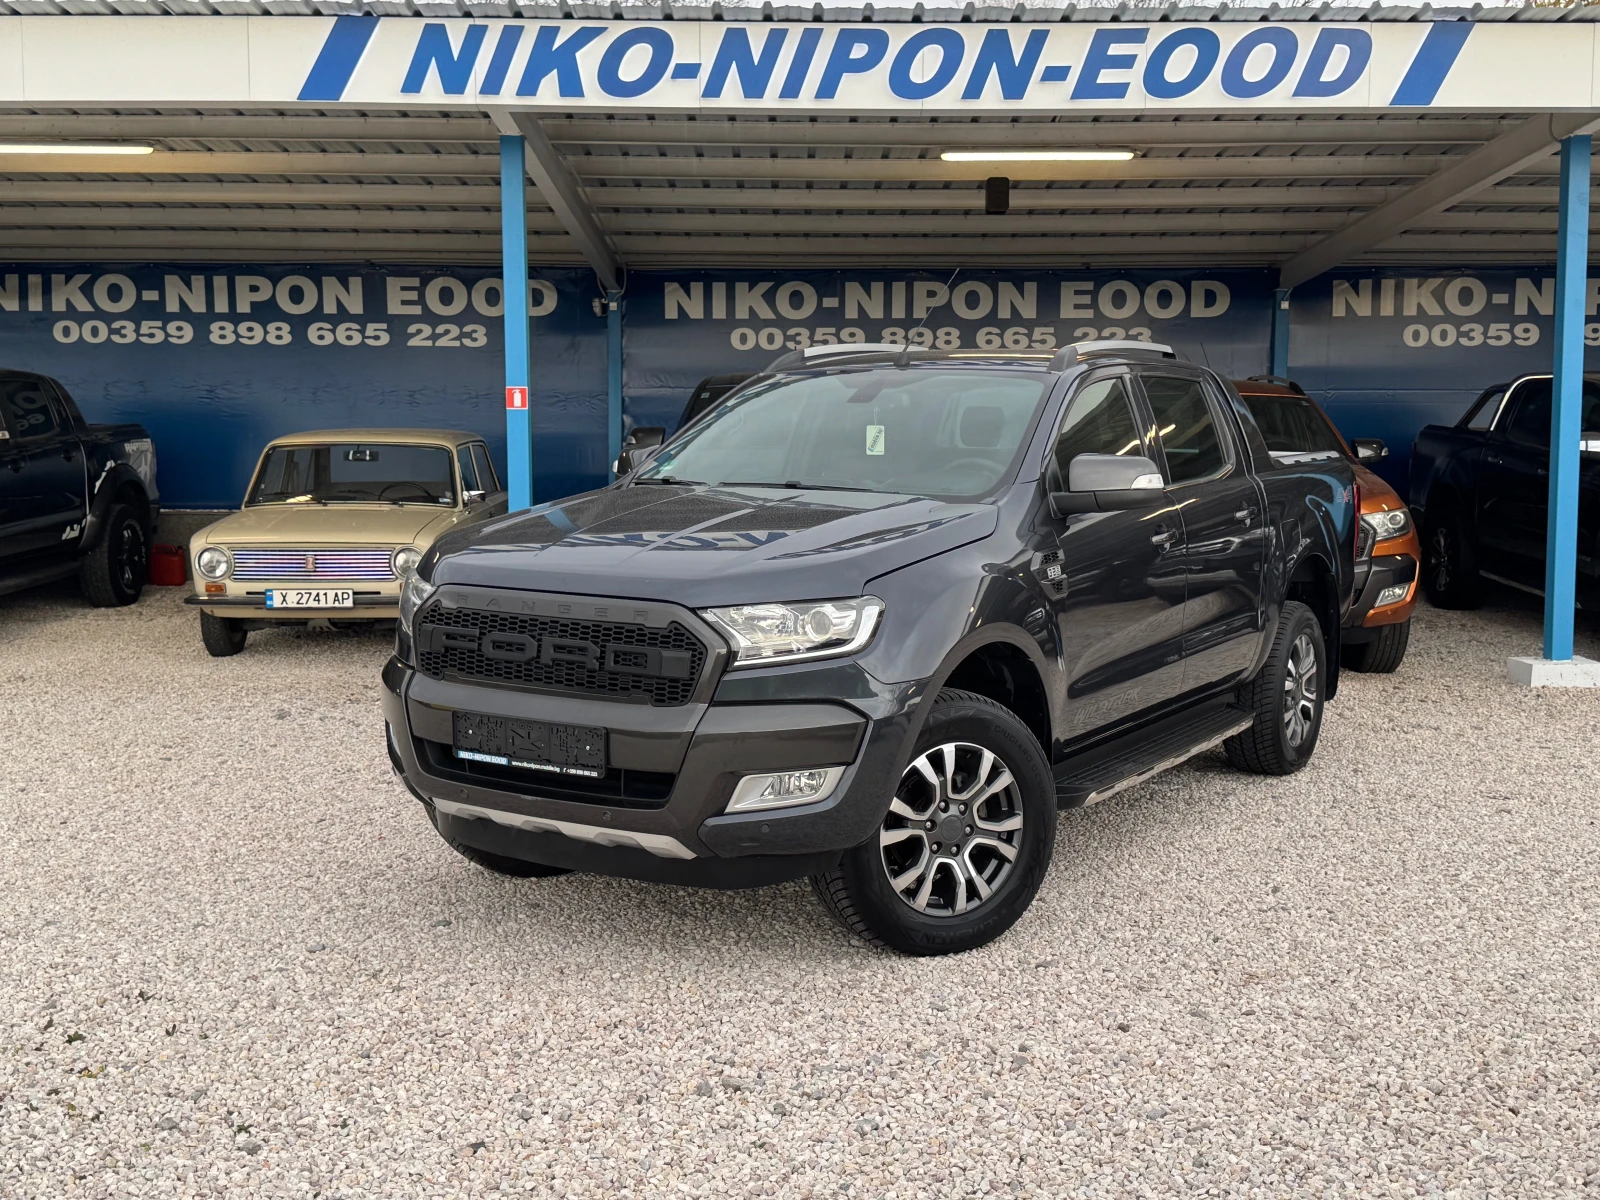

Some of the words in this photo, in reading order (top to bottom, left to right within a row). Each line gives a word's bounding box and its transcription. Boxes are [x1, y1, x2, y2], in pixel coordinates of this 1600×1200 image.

[400, 22, 1373, 99] NIKO-NIPON-EOOD
[386, 276, 558, 318] EOOD
[664, 281, 1037, 320] NIKO-NIPON
[1060, 280, 1231, 320] EOOD
[1332, 277, 1600, 317] NIKO-N
[53, 320, 194, 344] 00359
[209, 321, 292, 345] 898
[307, 322, 391, 346] 665
[406, 324, 488, 348] 223
[730, 327, 866, 351] 00359
[880, 327, 961, 350] 898
[975, 327, 1057, 350] 665
[1402, 323, 1540, 347] 00359
[296, 592, 328, 605] 2741
[456, 594, 649, 621] RANGER
[421, 624, 690, 680] FORD
